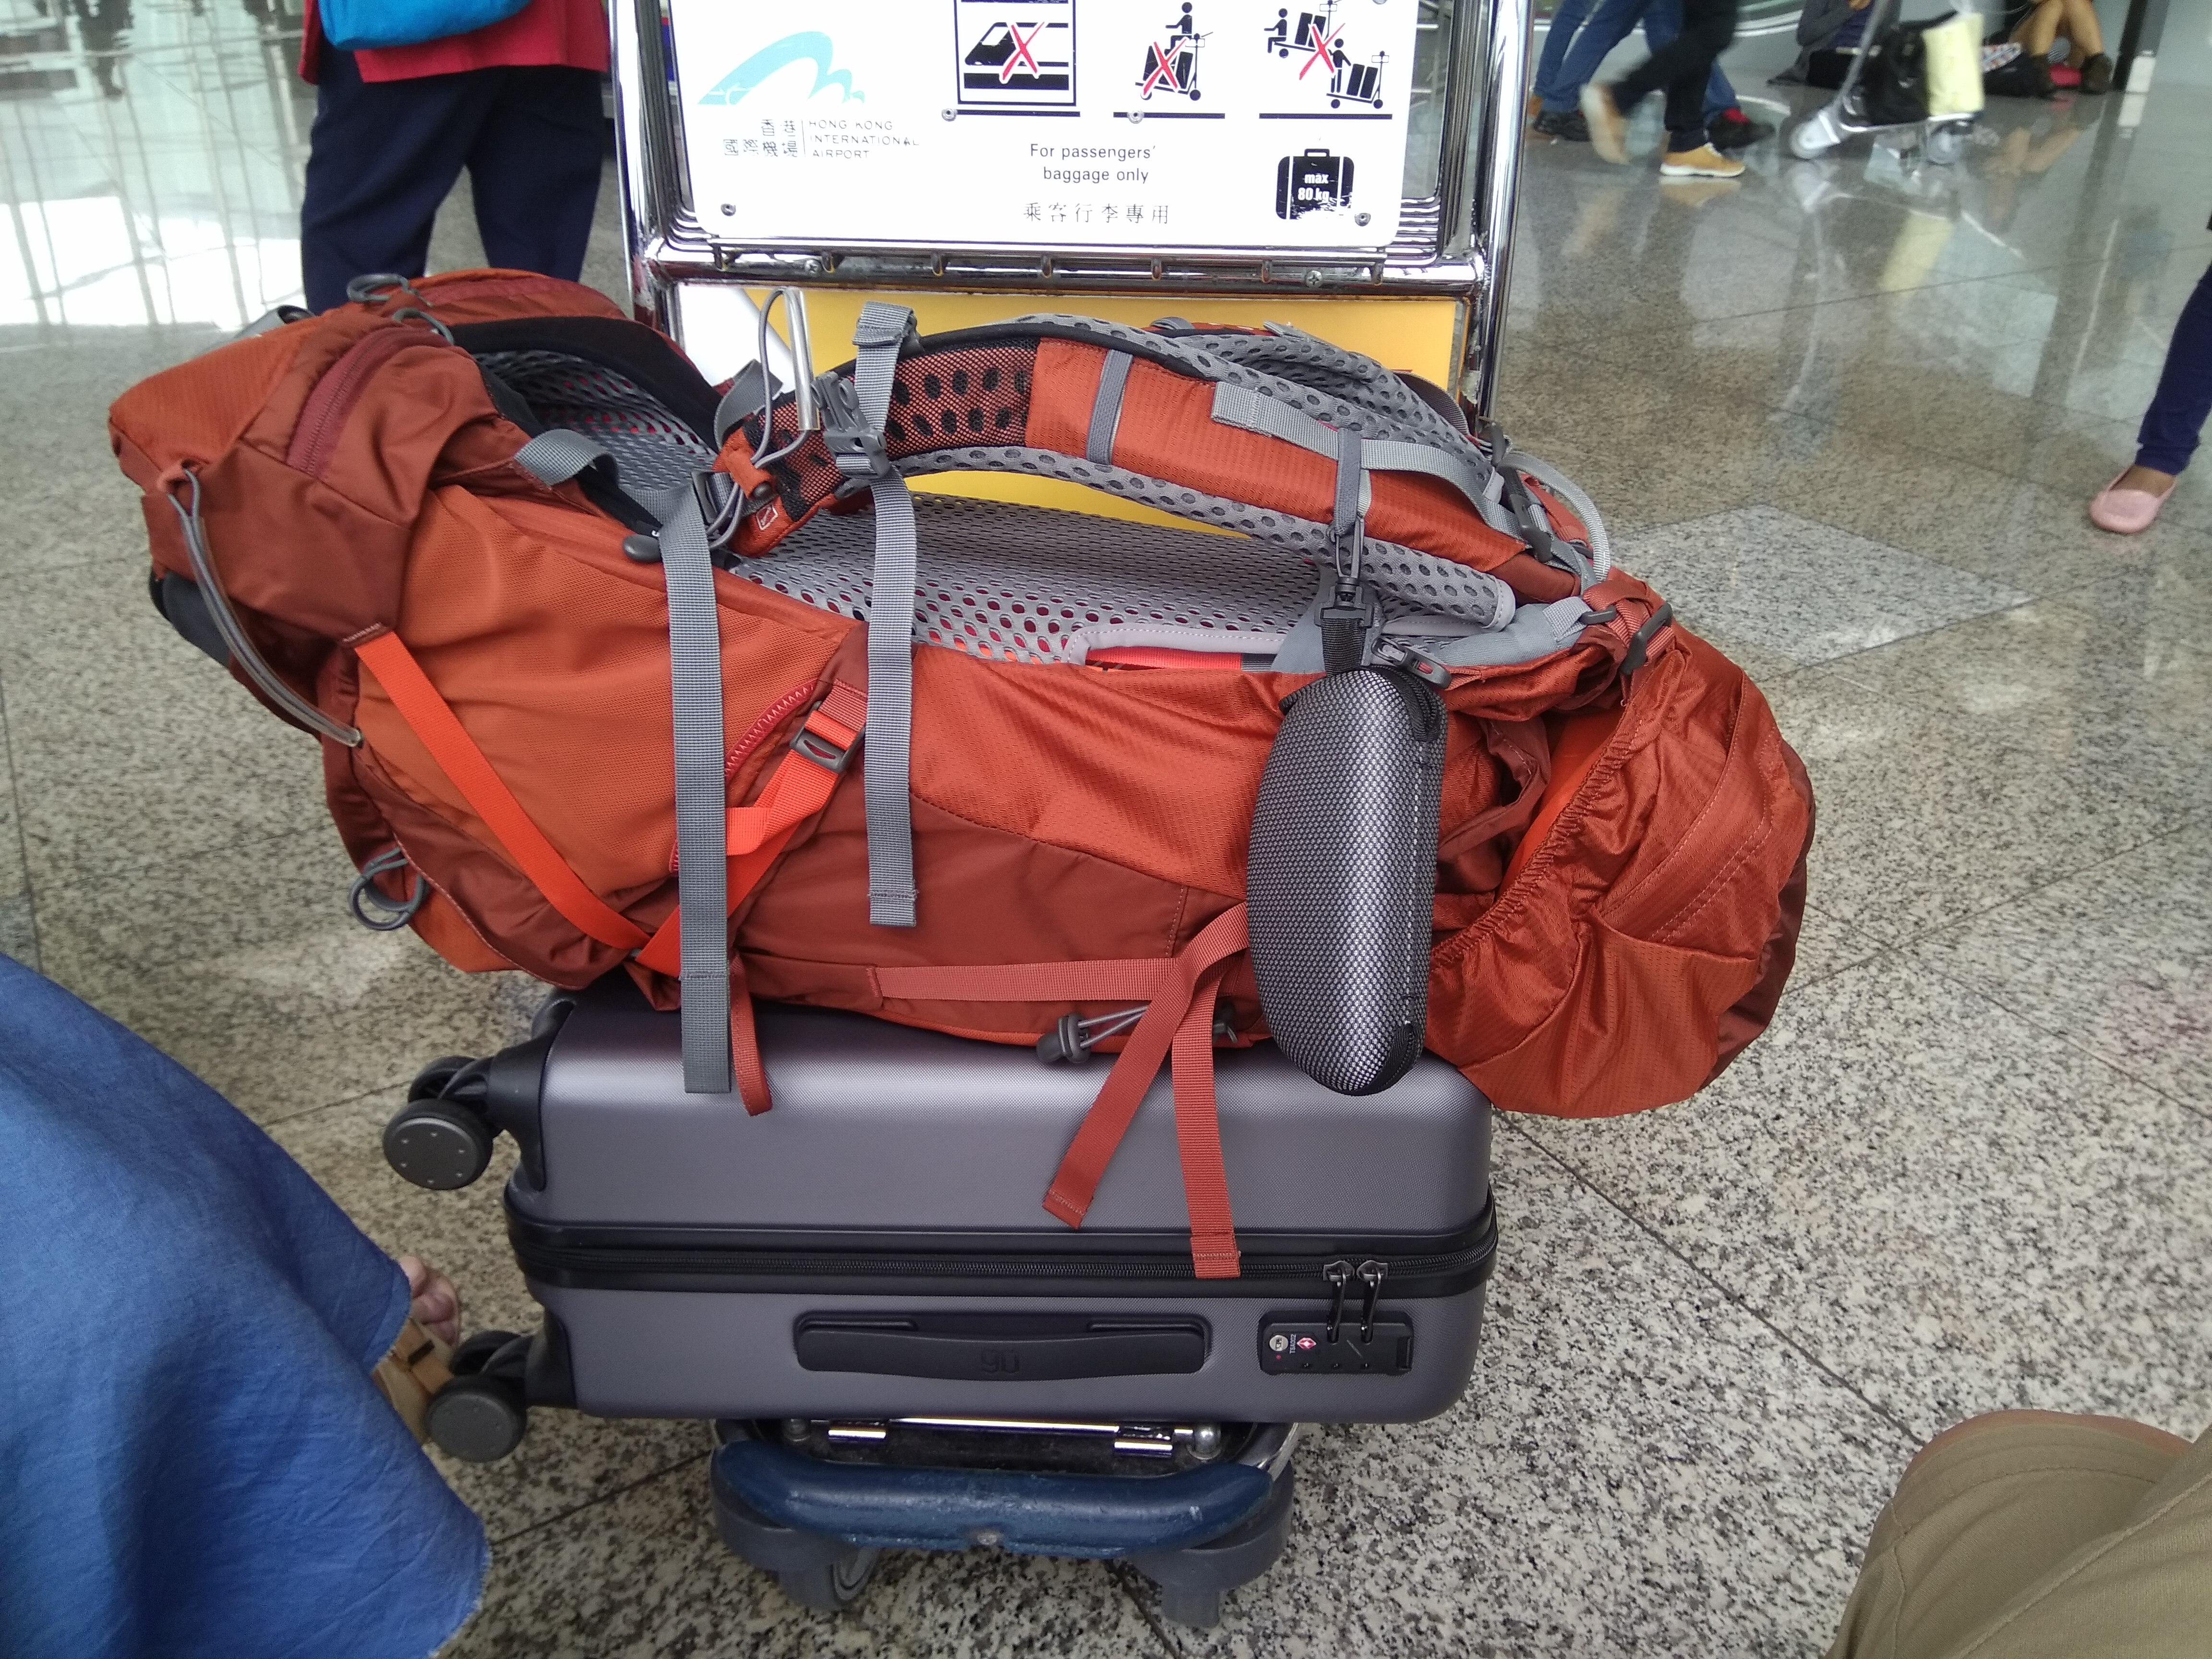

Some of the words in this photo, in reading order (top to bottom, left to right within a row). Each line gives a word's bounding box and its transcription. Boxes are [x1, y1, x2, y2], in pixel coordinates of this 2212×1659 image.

[761, 120, 796, 137] 香港
[809, 120, 847, 129] HONG
[855, 120, 893, 130] KONG
[810, 134, 919, 145] INTERNATIONAL
[813, 150, 870, 159] AIRPORT
[1031, 144, 1055, 157] For
[1044, 167, 1110, 184] baggage
[1117, 168, 1149, 184] only
[1304, 173, 1329, 184] max
[1298, 187, 1314, 201] 80
[1315, 187, 1330, 203] kg
[1023, 202, 1169, 224] 乘客行李專用
